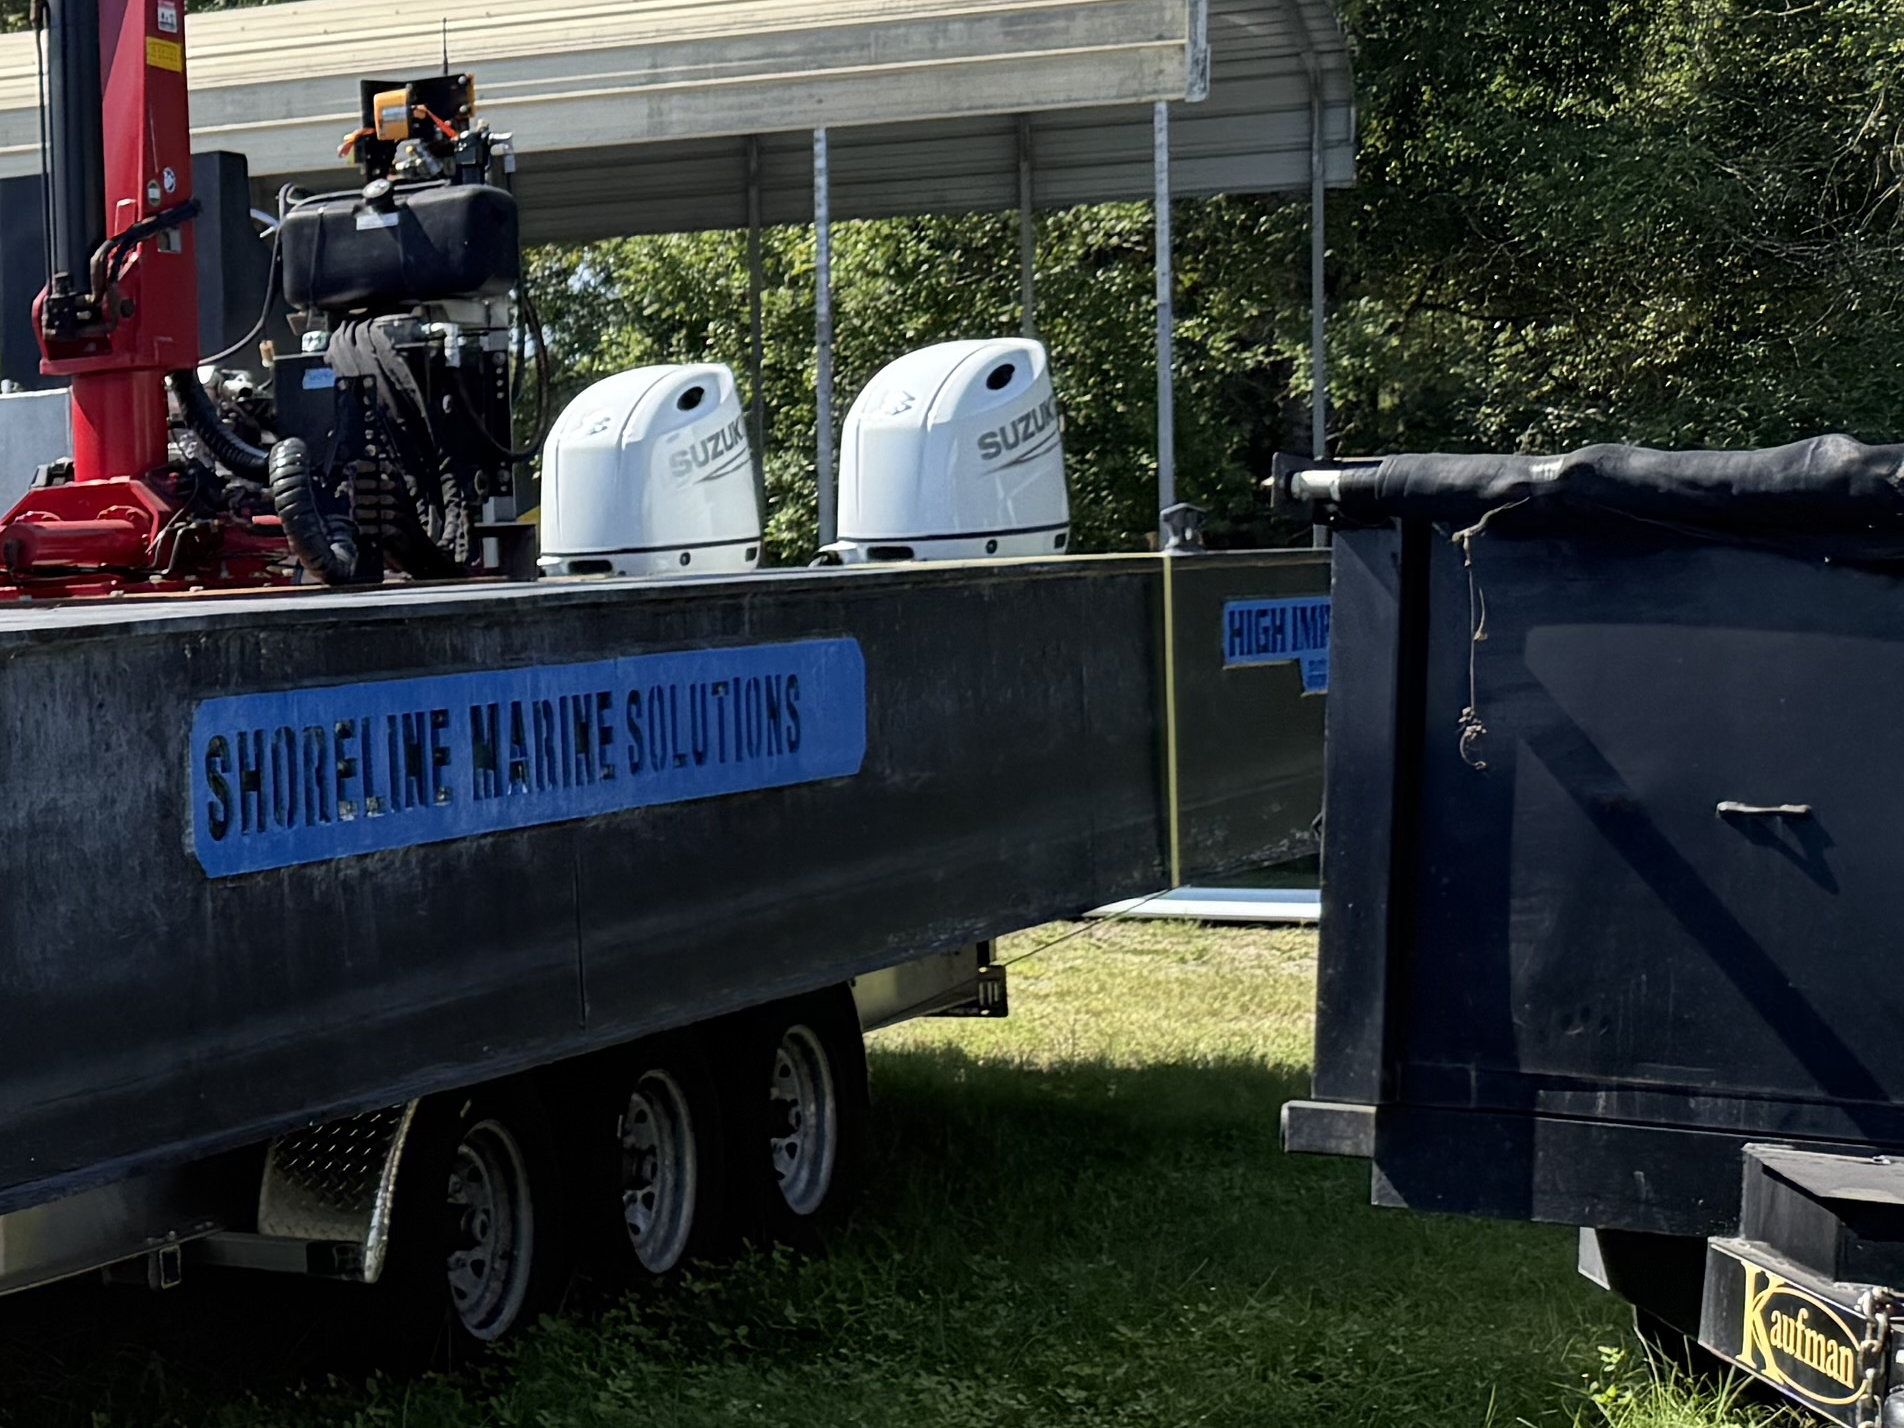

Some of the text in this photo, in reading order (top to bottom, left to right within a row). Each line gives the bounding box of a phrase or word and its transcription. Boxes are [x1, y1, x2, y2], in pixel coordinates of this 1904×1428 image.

[1228, 607, 1287, 657] HIGH
[205, 673, 802, 841] SHORELINE MARINE SOLUTIONS
[1735, 1259, 1855, 1390] Kaufman
